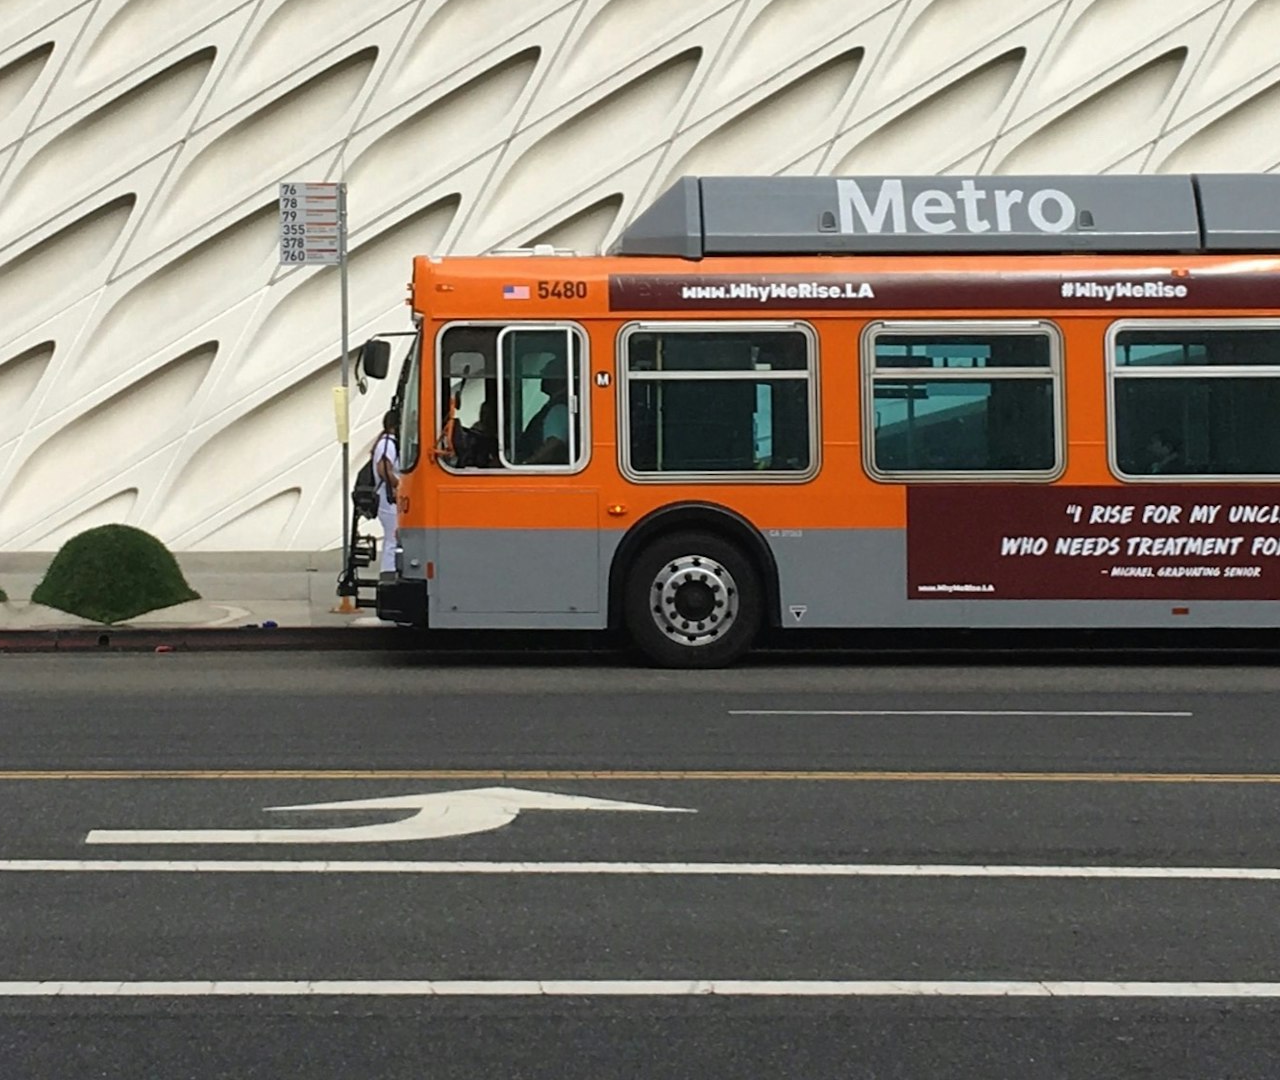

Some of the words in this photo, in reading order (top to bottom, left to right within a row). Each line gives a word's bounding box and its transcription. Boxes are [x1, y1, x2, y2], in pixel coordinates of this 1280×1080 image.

[282, 184, 297, 195] 76
[282, 198, 298, 209] 78
[836, 178, 1076, 234] Metro
[282, 211, 297, 222] 79
[283, 224, 305, 235] 355
[283, 238, 305, 248] 378
[283, 251, 305, 261] 760
[537, 281, 588, 299] 5480
[682, 282, 874, 302] www.WhyWeRise.LA
[1061, 282, 1188, 301] #WhyWeRise
[597, 373, 610, 386] M
[1089, 505, 1136, 525] RISE
[1142, 505, 1183, 525] FOR
[1189, 505, 1221, 525] MY
[1001, 536, 1049, 556] WHO
[1054, 537, 1121, 556] NEEDS
[1126, 536, 1245, 557] TREATMENT
[1157, 567, 1221, 577] GRADUATING
[1223, 567, 1262, 577] SENIOR
